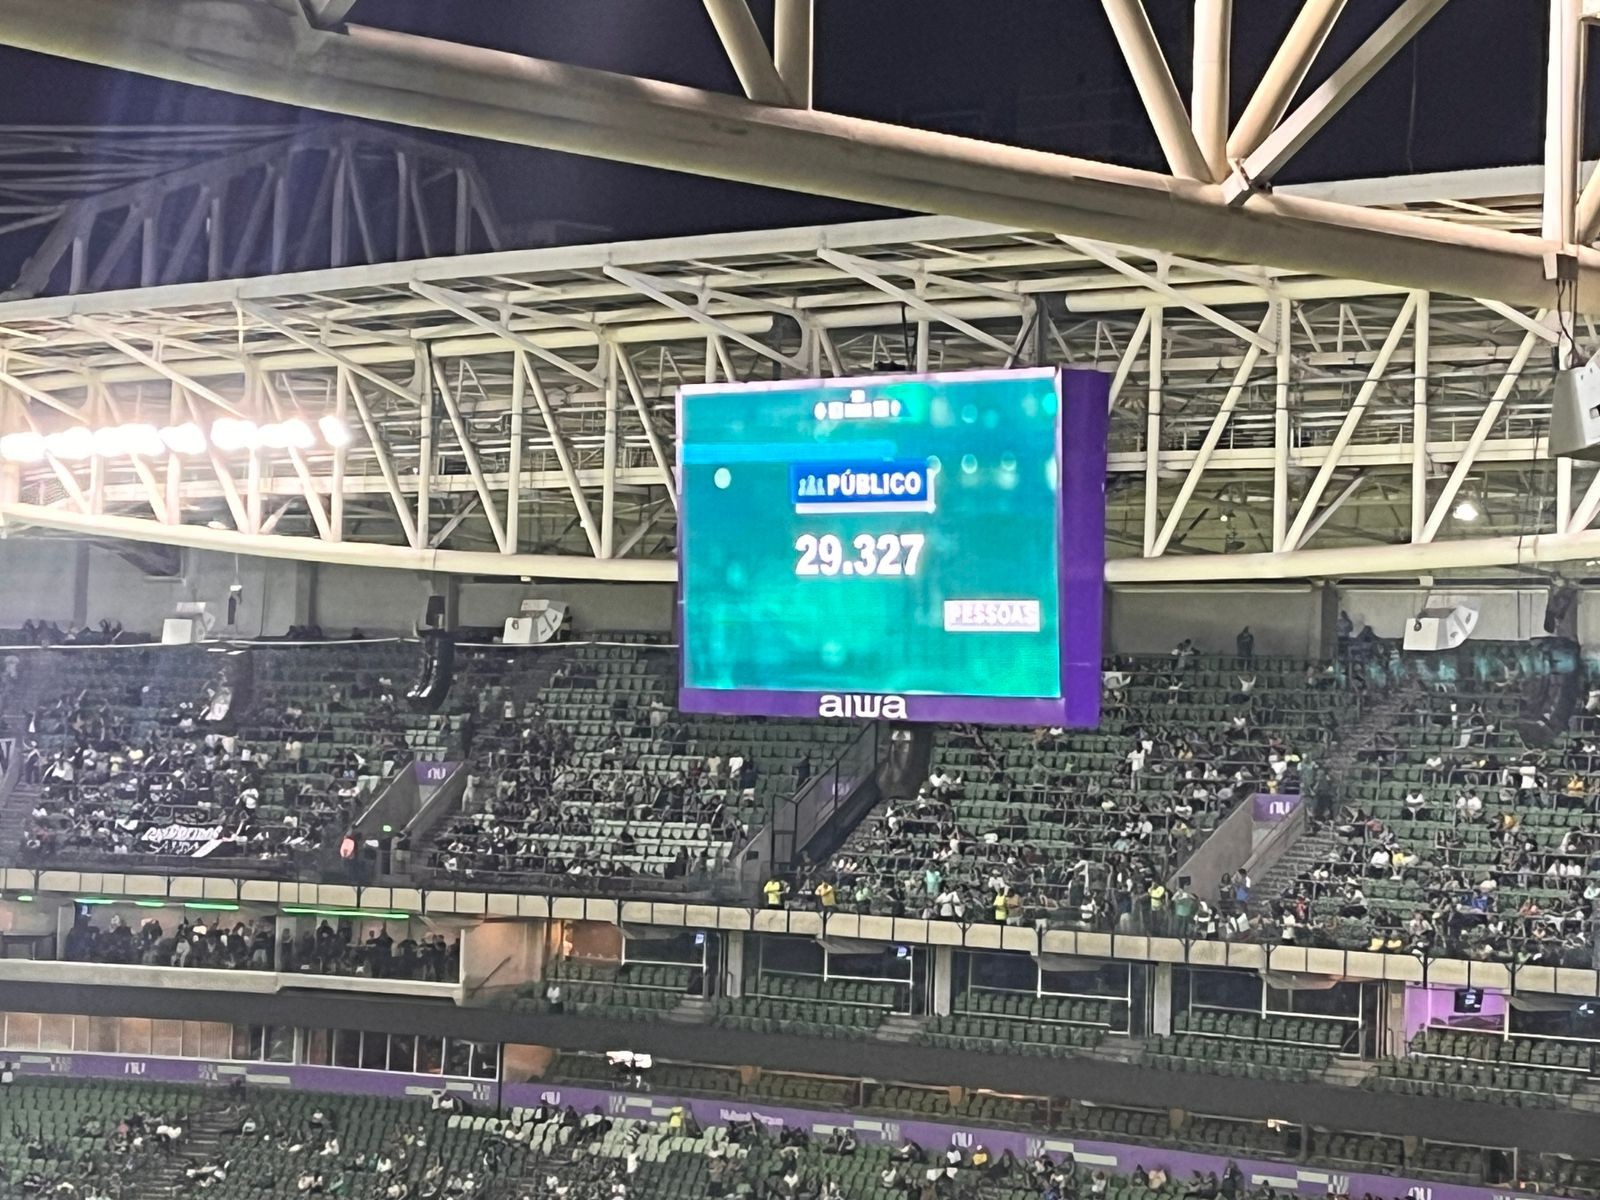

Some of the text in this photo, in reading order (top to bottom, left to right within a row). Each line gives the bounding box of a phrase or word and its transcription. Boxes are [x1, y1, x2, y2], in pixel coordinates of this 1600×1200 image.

[826, 468, 922, 496] PÚBLICO
[795, 533, 925, 576] 29.327
[949, 603, 1036, 626] PESSOAS
[819, 694, 908, 719] aiwa
